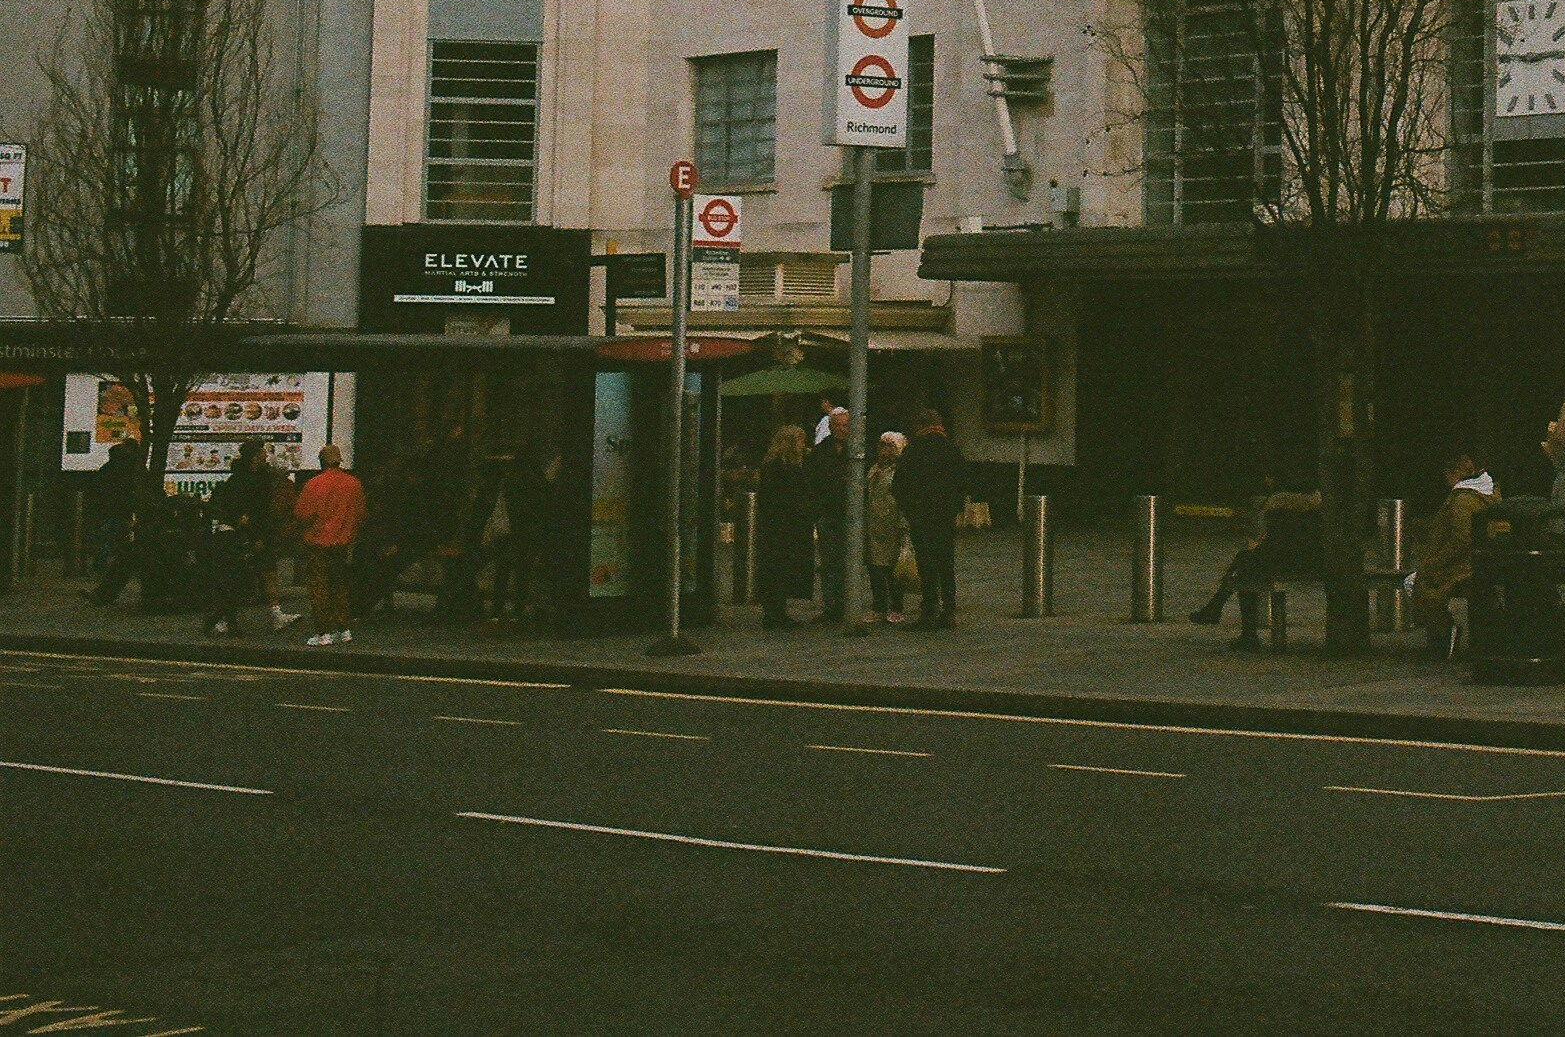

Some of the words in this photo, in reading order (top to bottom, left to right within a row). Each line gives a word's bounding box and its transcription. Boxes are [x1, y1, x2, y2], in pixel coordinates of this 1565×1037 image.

[852, 7, 898, 18] OVERGROUND
[847, 76, 899, 88] UNDERGROUND
[846, 121, 898, 135] Richmond
[678, 166, 691, 189] E
[424, 253, 528, 269] ELEVATE
